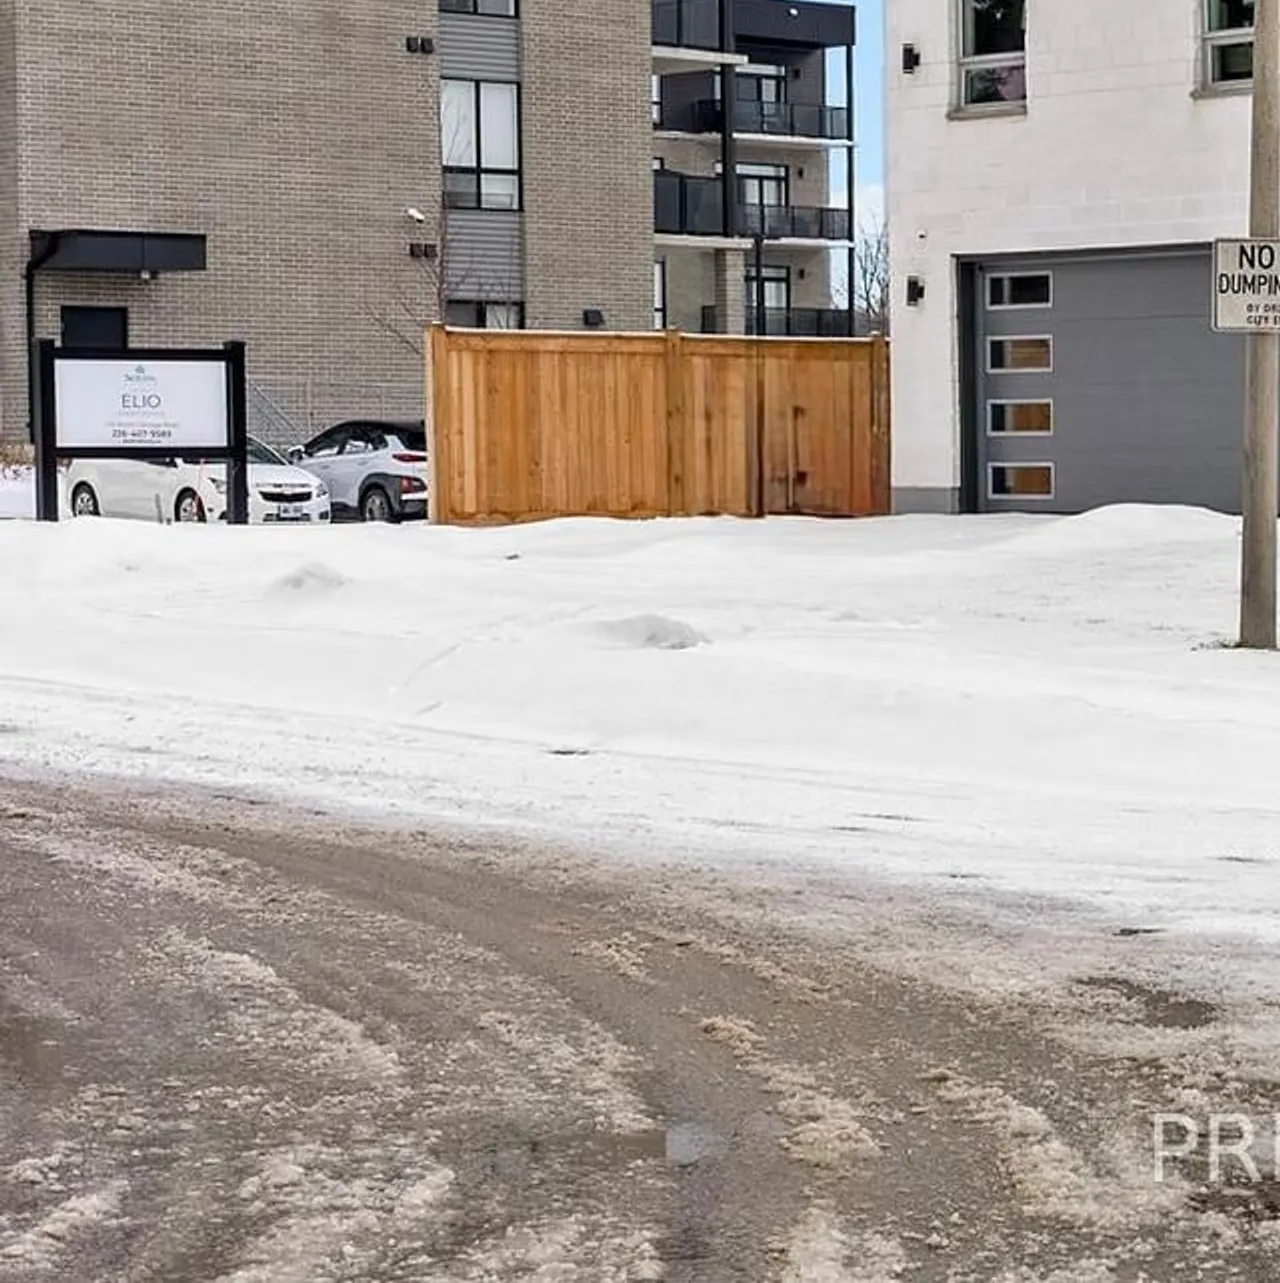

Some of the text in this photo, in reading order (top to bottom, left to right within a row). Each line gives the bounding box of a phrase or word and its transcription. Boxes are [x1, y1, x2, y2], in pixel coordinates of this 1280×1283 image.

[1239, 245, 1275, 269] NO
[1246, 303, 1260, 313] BY
[1246, 315, 1269, 325] CITY
[121, 394, 161, 408] ELIO
